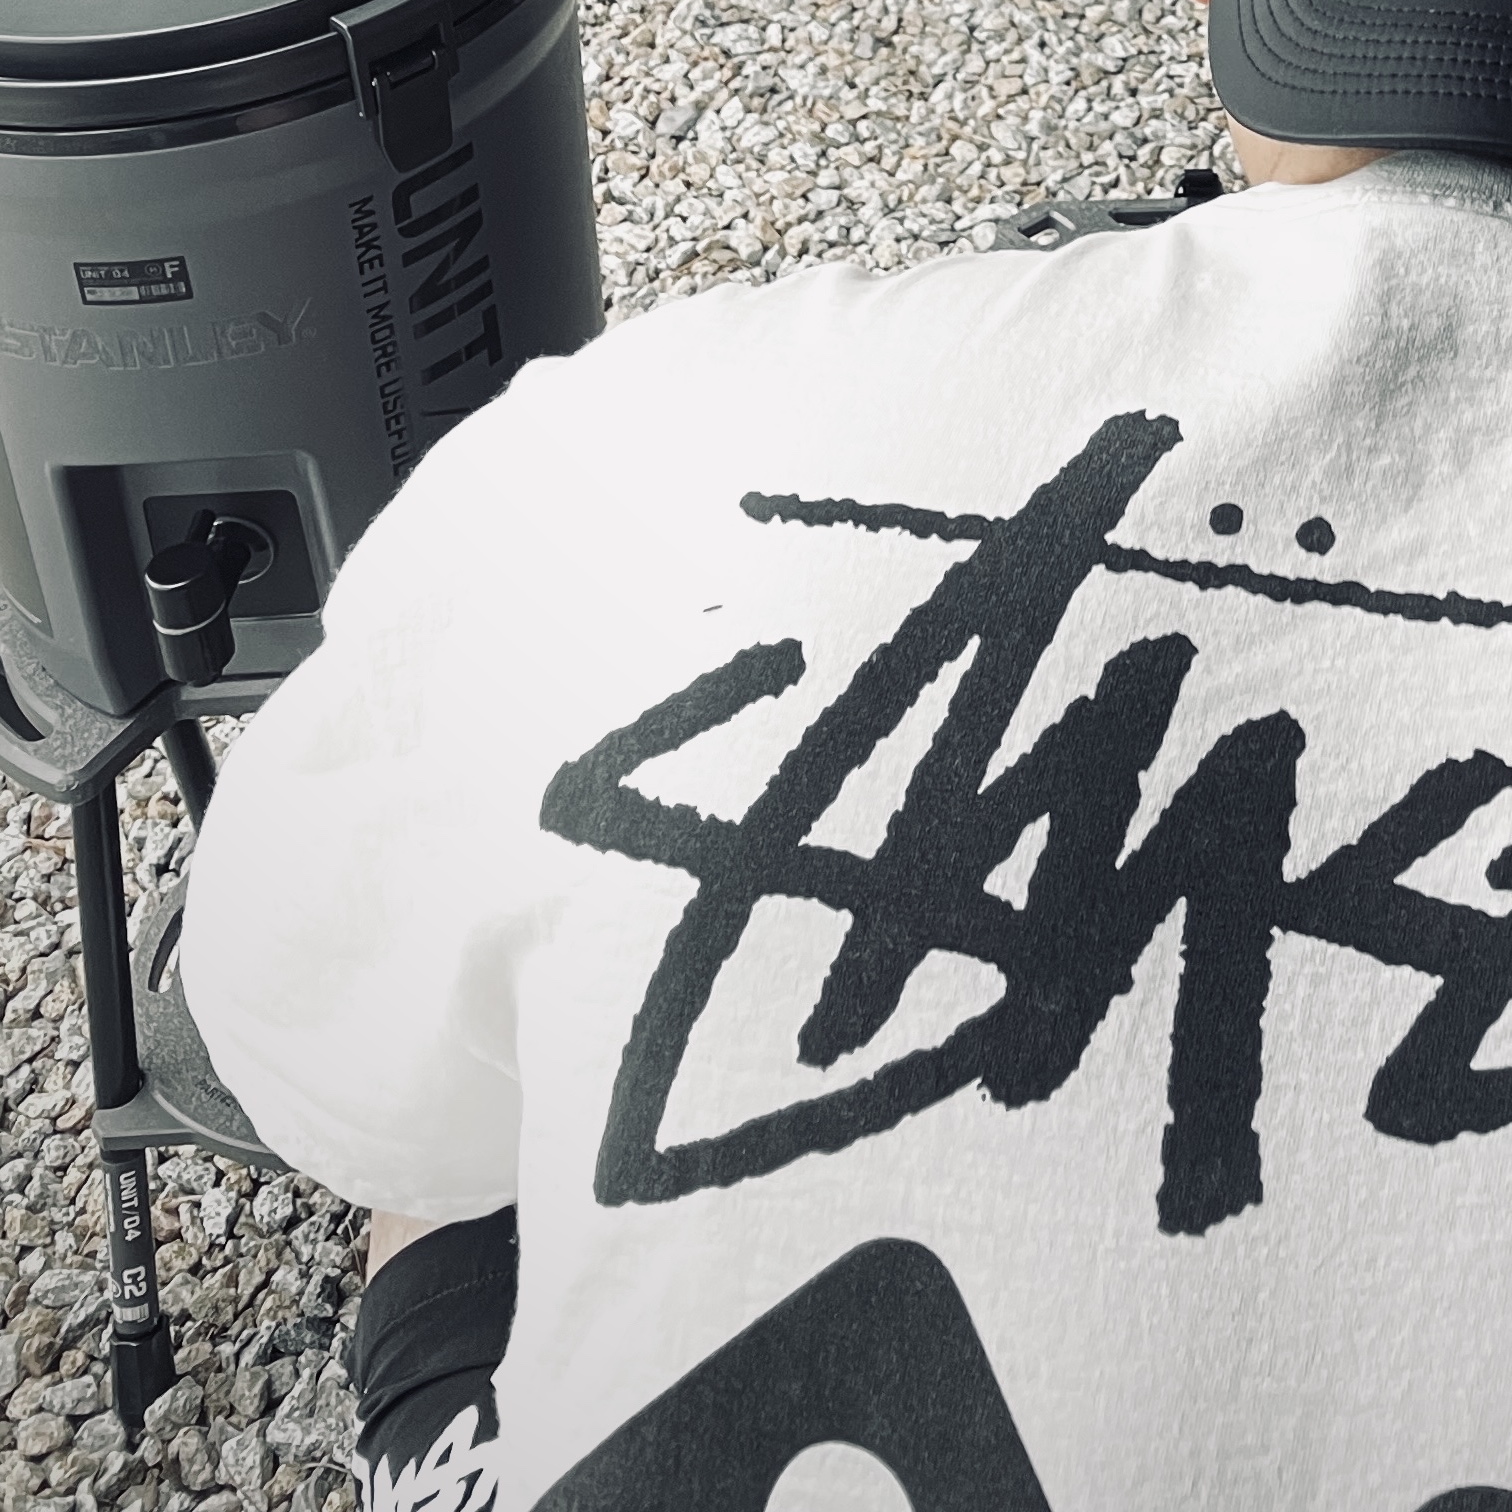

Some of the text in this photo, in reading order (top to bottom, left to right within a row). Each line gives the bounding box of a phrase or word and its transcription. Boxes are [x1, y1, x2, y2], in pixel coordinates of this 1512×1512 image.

[348, 194, 385, 276] MAKE
[80, 268, 106, 280] UNIT
[361, 273, 390, 300] IT
[0, 296, 312, 370] STANLEY
[366, 299, 398, 379] MORE
[119, 1169, 142, 1242] UNIT/04
[121, 1264, 148, 1301] C2
